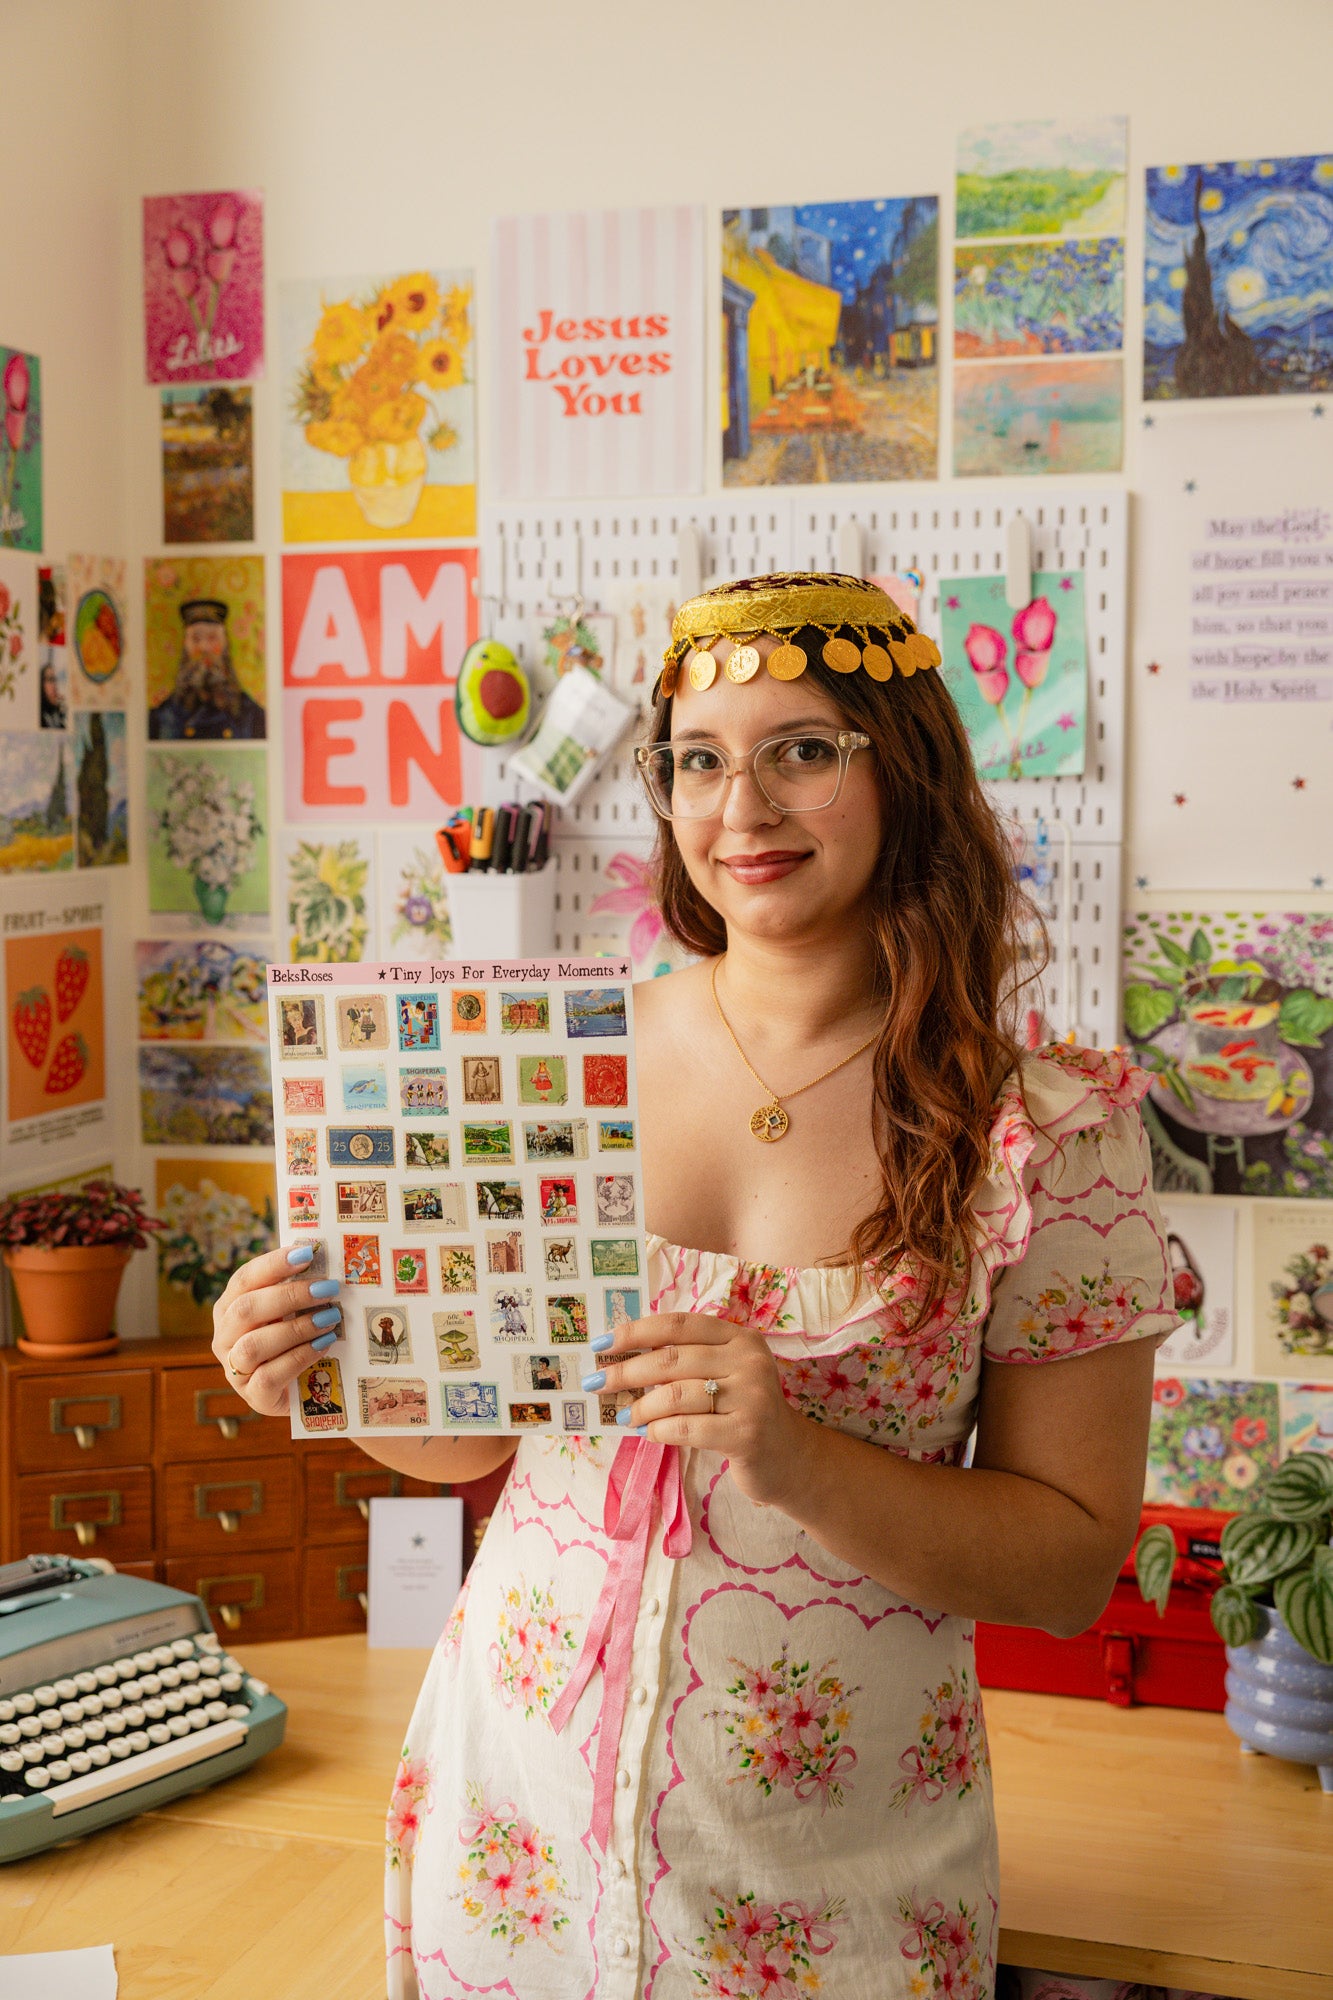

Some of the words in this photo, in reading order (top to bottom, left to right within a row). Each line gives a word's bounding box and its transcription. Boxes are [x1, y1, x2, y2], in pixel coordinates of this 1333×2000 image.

[523, 309, 669, 344] Jesus
[525, 348, 671, 381] Loves
[553, 382, 643, 417] You
[1210, 519, 1244, 537] May
[1251, 517, 1276, 534] the
[1282, 517, 1320, 534] God
[1248, 582, 1279, 601] and
[1284, 586, 1329, 605] peace
[290, 562, 468, 680] AM
[1304, 648, 1330, 666] the
[1269, 680, 1318, 700] Spirit
[302, 699, 464, 808] EN
[271, 968, 333, 983] BeksRoses
[389, 967, 422, 985] Tiny
[429, 965, 455, 984] Joys
[461, 966, 485, 979] For
[492, 964, 551, 982] Everyday
[557, 963, 614, 977] Moments
[405, 1067, 441, 1075] SHQIPERIA
[345, 1103, 387, 1111] SHQIPERIA
[333, 1141, 347, 1152] 25
[377, 1141, 391, 1152] 25
[305, 1414, 345, 1428] SHQIPERIA
[410, 1416, 422, 1424] 80
[602, 1408, 617, 1418] 40
